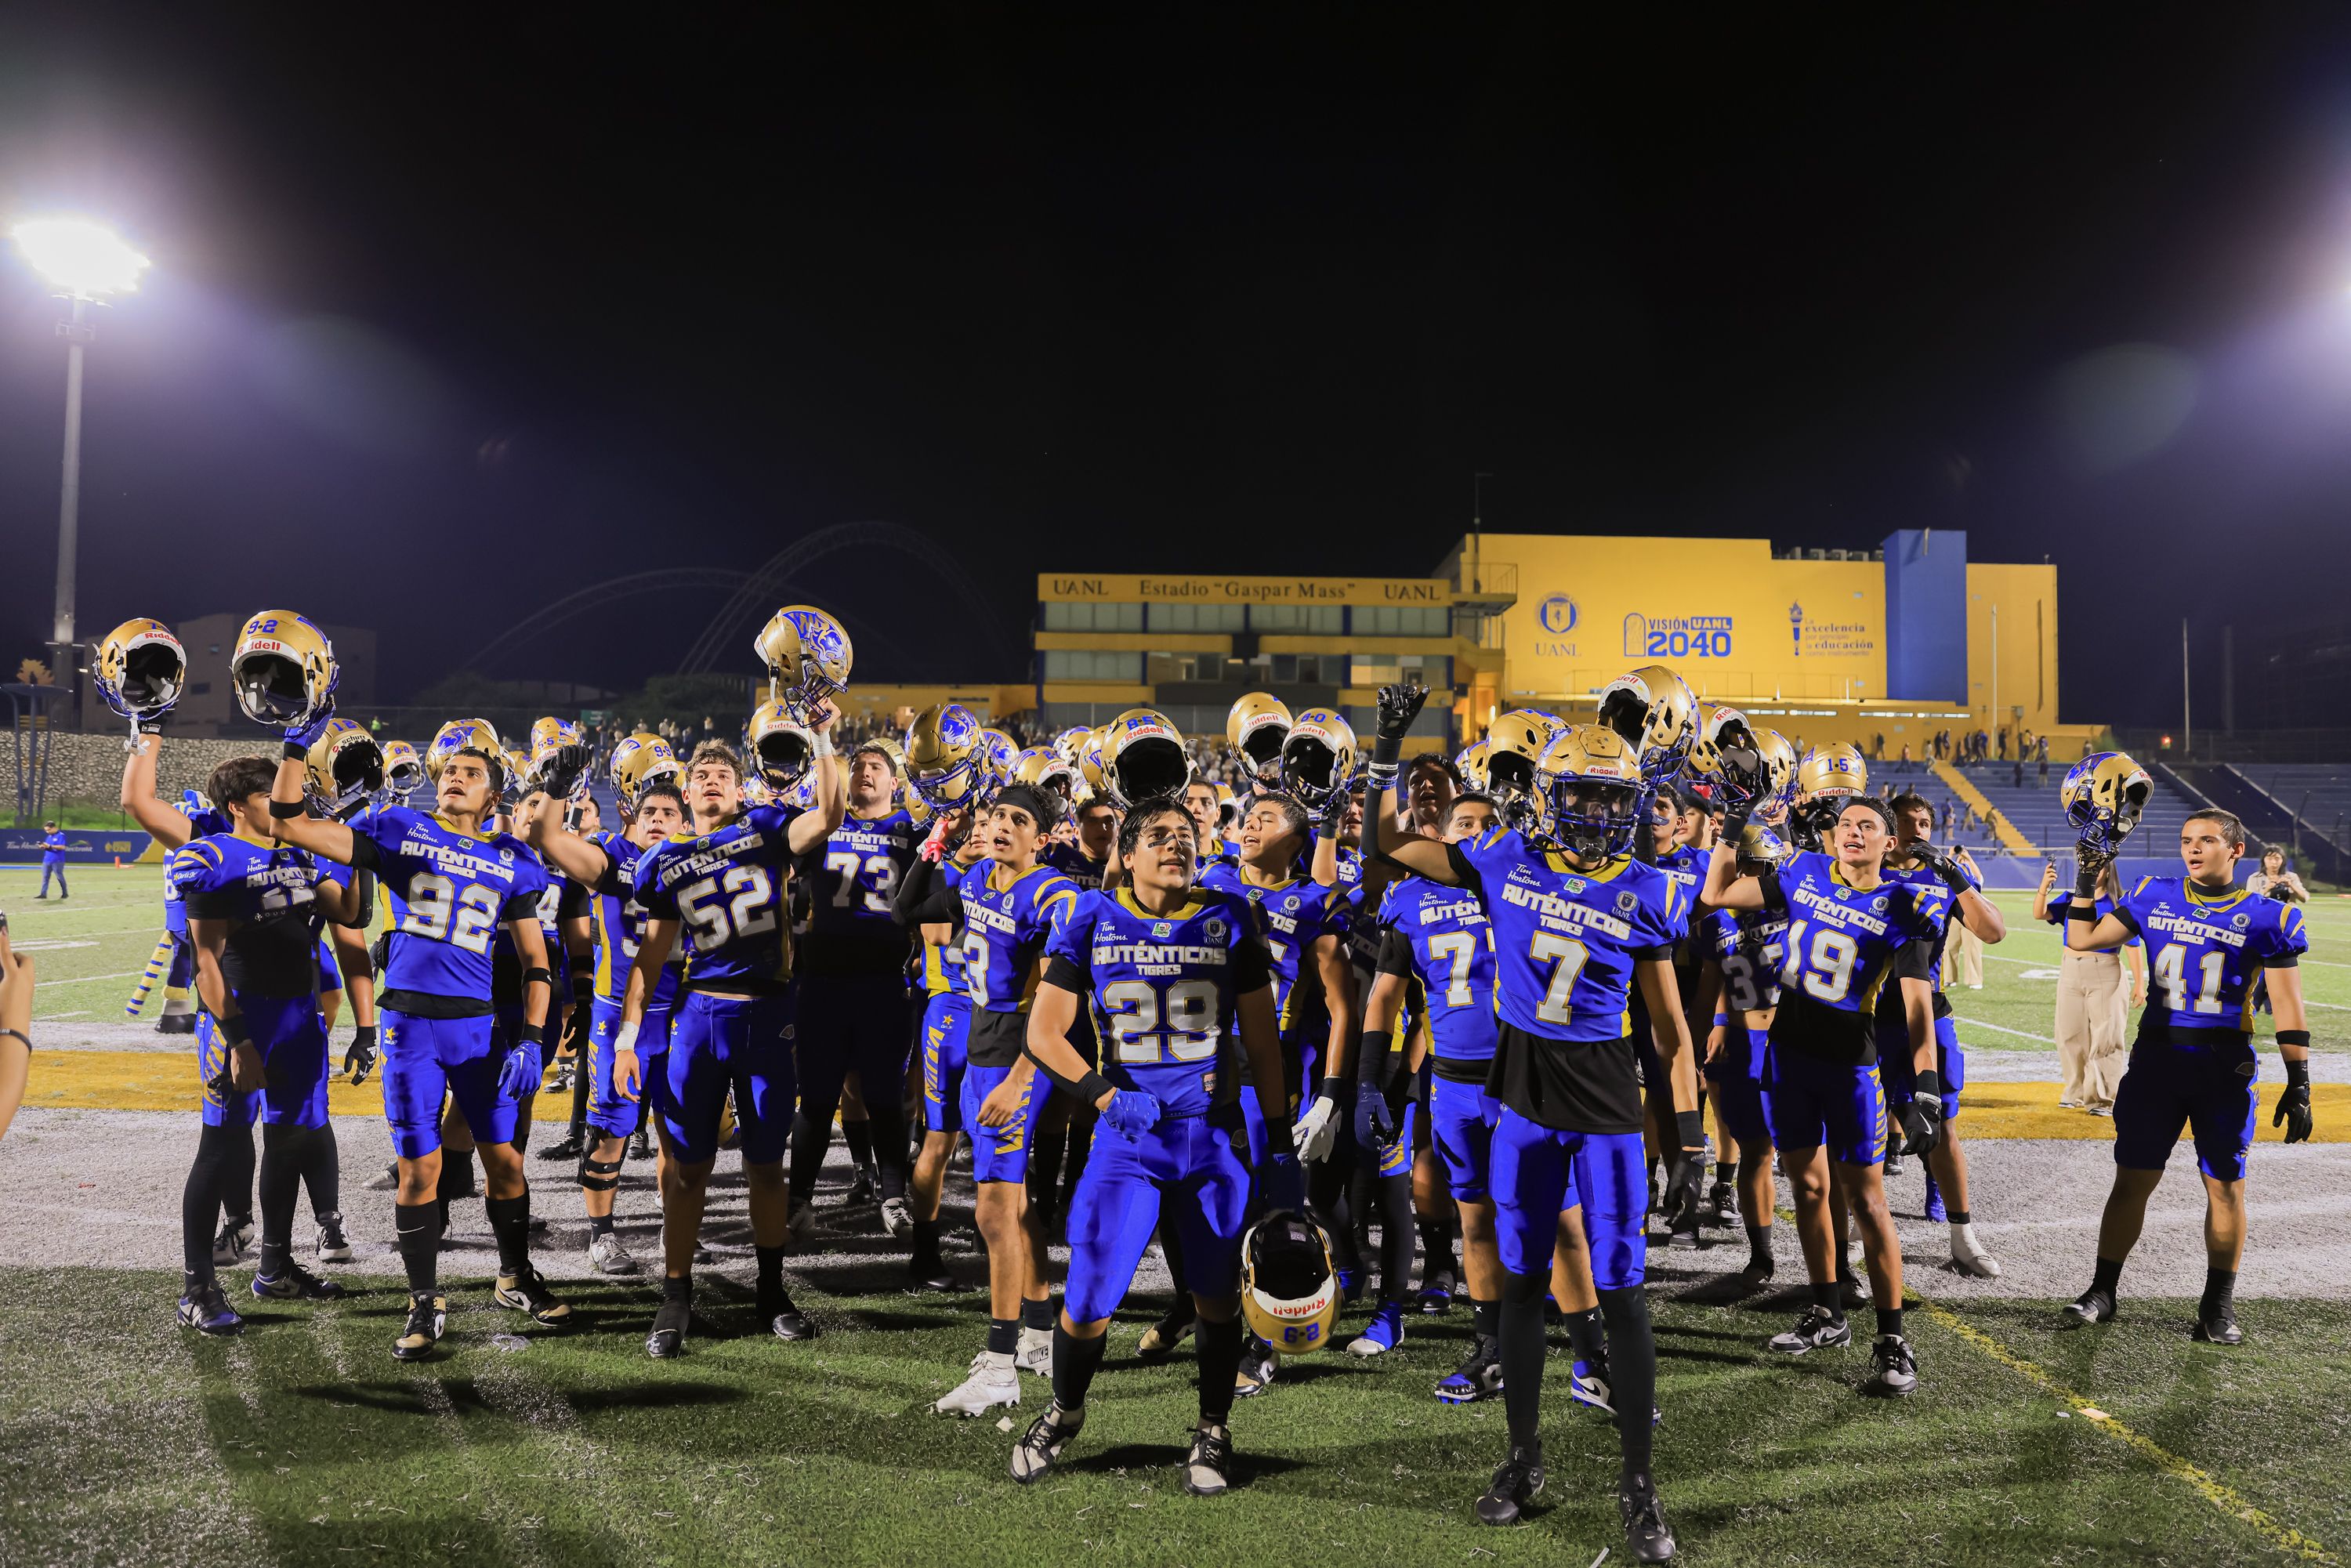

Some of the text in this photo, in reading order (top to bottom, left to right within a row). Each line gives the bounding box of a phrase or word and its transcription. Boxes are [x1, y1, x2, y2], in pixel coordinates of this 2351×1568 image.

[1053, 580, 1109, 596] UANL
[1139, 580, 1208, 596] Estadio
[1385, 584, 1440, 600] UANL
[1649, 617, 1730, 630] VISIÓN UANL
[1806, 623, 1865, 632] excelencia
[1535, 643, 1581, 657] UANL
[1648, 632, 1731, 657] 2040
[1815, 639, 1873, 648] educación
[1617, 675, 1639, 684] dell
[1125, 726, 1165, 742] Riddell
[1290, 727, 1326, 737] Riddell
[1590, 766, 1619, 776] Riddell
[1818, 788, 1853, 796] Riddell
[415, 822, 429, 833] Tim
[248, 856, 261, 865] Tim
[400, 840, 515, 884] AUTÉNTICOS
[498, 859, 514, 868] UANL
[657, 853, 671, 863] Tim
[661, 832, 764, 887] AUTÉNTICOS
[694, 859, 730, 877] TIGRES
[1516, 863, 1532, 875] Tim
[827, 852, 900, 912] 73
[1806, 874, 1816, 883] Tim
[401, 871, 501, 954] 92
[676, 864, 776, 952] 52
[1419, 900, 1481, 925] AUTÉN
[1502, 883, 1632, 940] AUTÉNTICOS
[1611, 907, 1631, 920] UANL
[1792, 888, 1887, 936] AUTÉNTICOS
[1868, 907, 1884, 918] UANL
[1100, 921, 1116, 932] Tim
[1540, 914, 1584, 936] TIGRES
[1813, 909, 1846, 929] TIGRES
[2147, 916, 2247, 947] AUTÉNTICOS
[2229, 925, 2247, 934] UANL
[1092, 940, 1227, 965] AUTÉNTICOS
[1428, 928, 1495, 1008] 7
[1780, 919, 1859, 1003] 19
[1136, 964, 1182, 976] TIGRES
[1530, 930, 1590, 1025] 7
[2155, 943, 2226, 1014] 41
[1103, 980, 1222, 1063] 29
[1273, 1297, 1325, 1316] Riddell
[1028, 1345, 1049, 1364] NIKE
